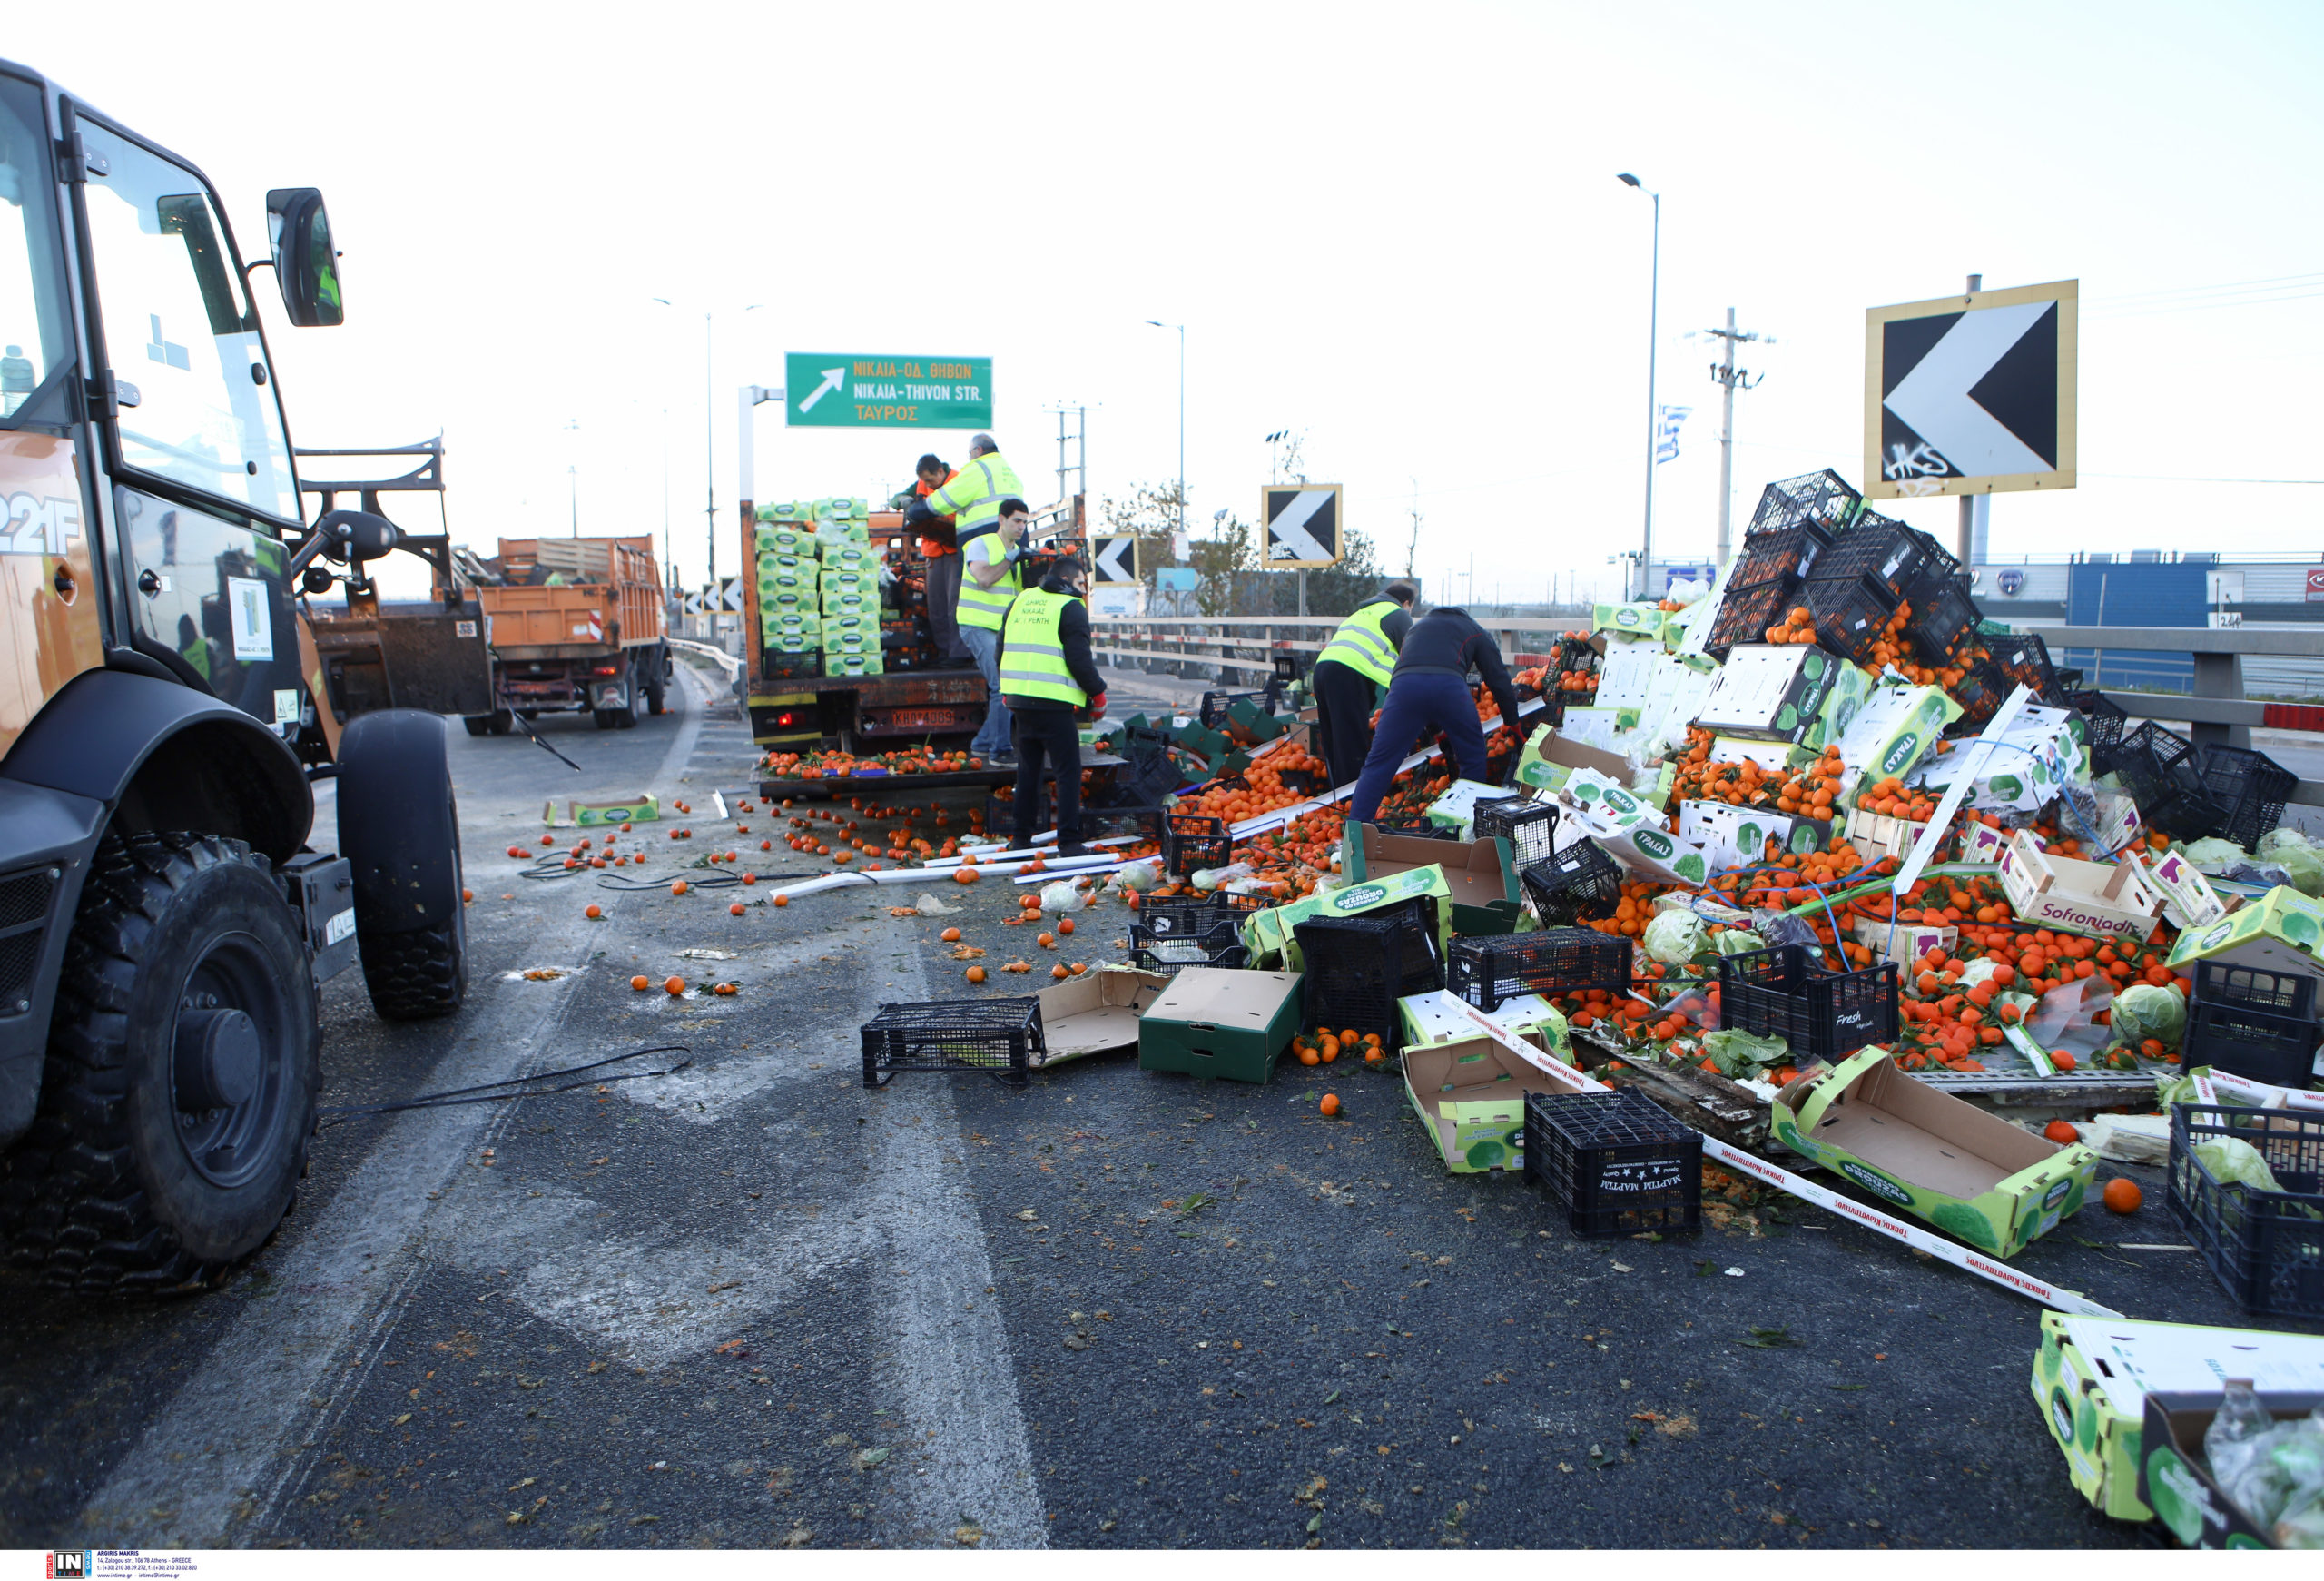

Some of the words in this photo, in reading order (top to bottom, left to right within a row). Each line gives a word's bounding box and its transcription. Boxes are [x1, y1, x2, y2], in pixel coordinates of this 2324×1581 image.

[853, 361, 924, 378] ΝΙΚΑΙΑ-ΟΔ.
[930, 363, 972, 379] ΘΗΒΩΝ
[853, 383, 950, 400] NIKAIA-THIVON
[955, 387, 983, 401] STR.
[855, 405, 918, 421] ΤΑΥΡΟΣ
[1884, 734, 1915, 773] ΤΡΑΚΑΣ
[1638, 832, 1671, 856] ΤΡΑΚΑΣ
[1337, 889, 1384, 906] DROUZAS
[1836, 1010, 1861, 1026] Fresh
[1844, 1163, 1908, 1201] DROUZAS
[1882, 1220, 1907, 1238] Τρακας
[1965, 1256, 2020, 1287] Κωνσταντινος
[2022, 1279, 2052, 1299] Τρακας
